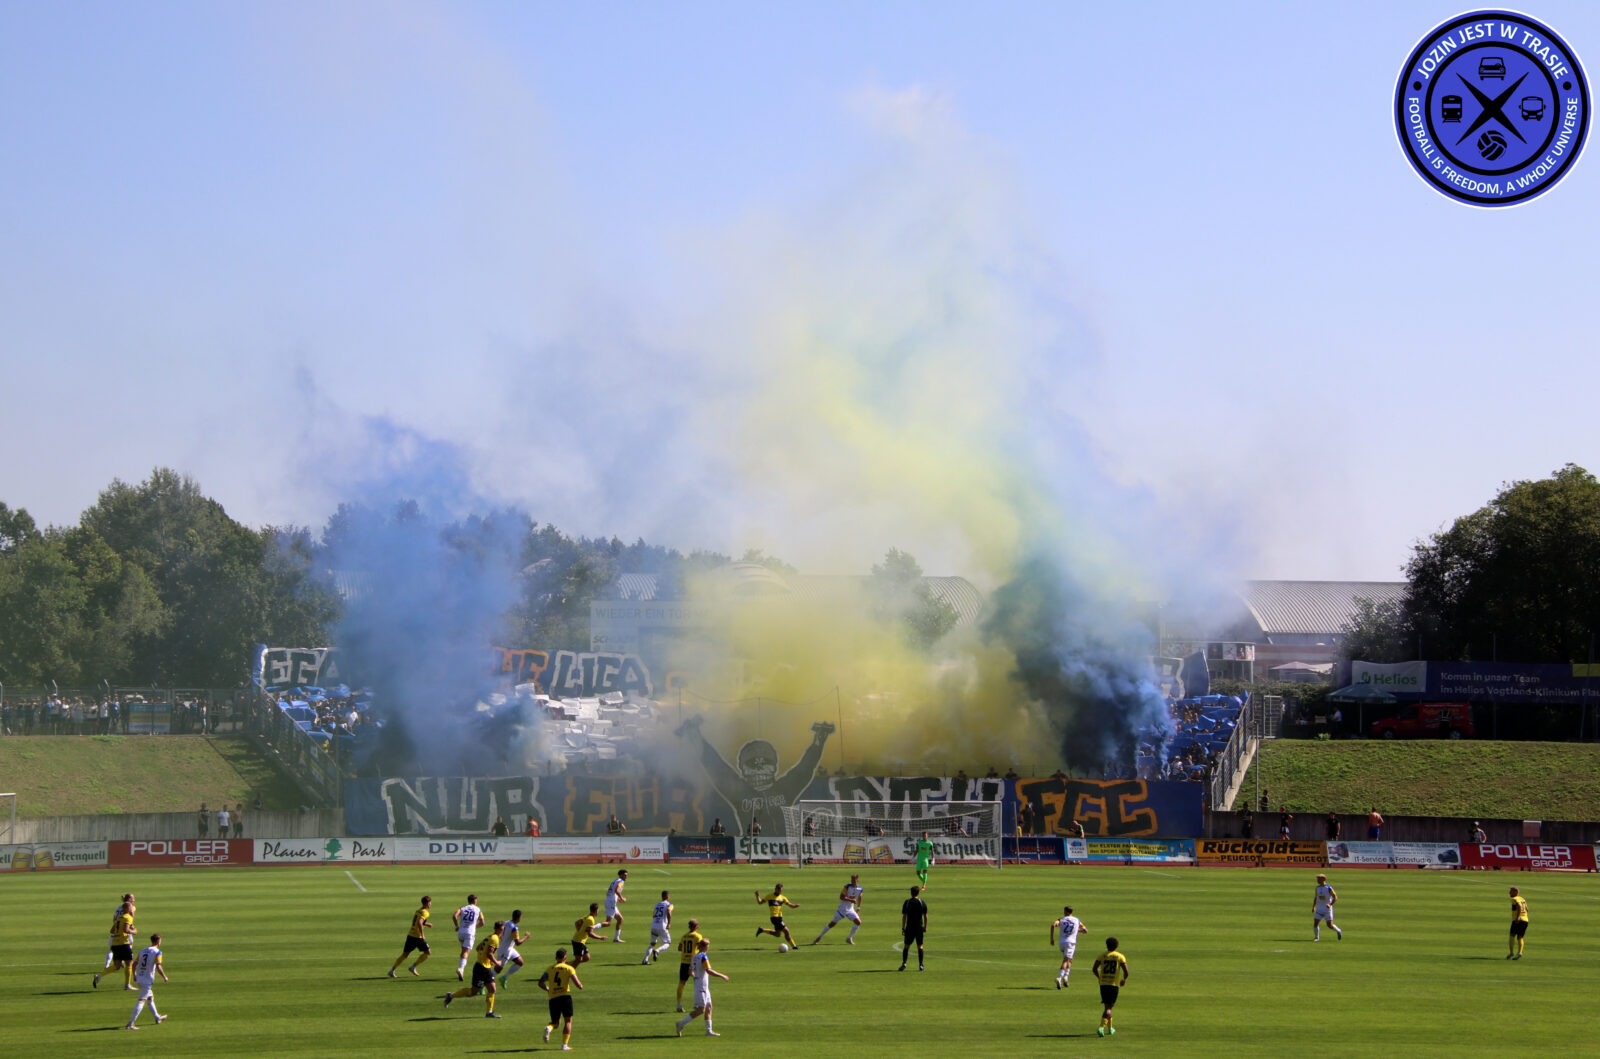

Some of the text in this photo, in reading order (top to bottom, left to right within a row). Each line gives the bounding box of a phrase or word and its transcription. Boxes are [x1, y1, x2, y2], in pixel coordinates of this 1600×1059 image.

[594, 607, 641, 619] WIEDER
[645, 607, 665, 619] EIN
[549, 648, 654, 700] LIGA
[1373, 673, 1418, 685] Helios
[1441, 672, 1541, 683] Komm in unser Team
[1440, 684, 1453, 694] im
[1455, 685, 1484, 695] Helios
[1486, 686, 1580, 697] Vogtland-Klinikum
[381, 776, 547, 834] NUR
[1015, 778, 1158, 836] FCC
[130, 840, 229, 855] POLLER
[261, 841, 317, 859] Plauen
[351, 840, 386, 859] Park
[429, 841, 498, 854] DDHW
[739, 837, 833, 857] Sternquell
[1202, 839, 1299, 854] Rückoldt
[1479, 844, 1572, 860] POLLER
[54, 850, 105, 863] Sternquell
[184, 855, 229, 863] GROUP
[1531, 859, 1573, 868] GROUP
[462, 910, 475, 922] 28
[654, 906, 664, 918] 25
[682, 940, 693, 954] 10
[141, 953, 149, 968] 3
[1103, 960, 1117, 975] 28
[553, 971, 562, 987] 4
